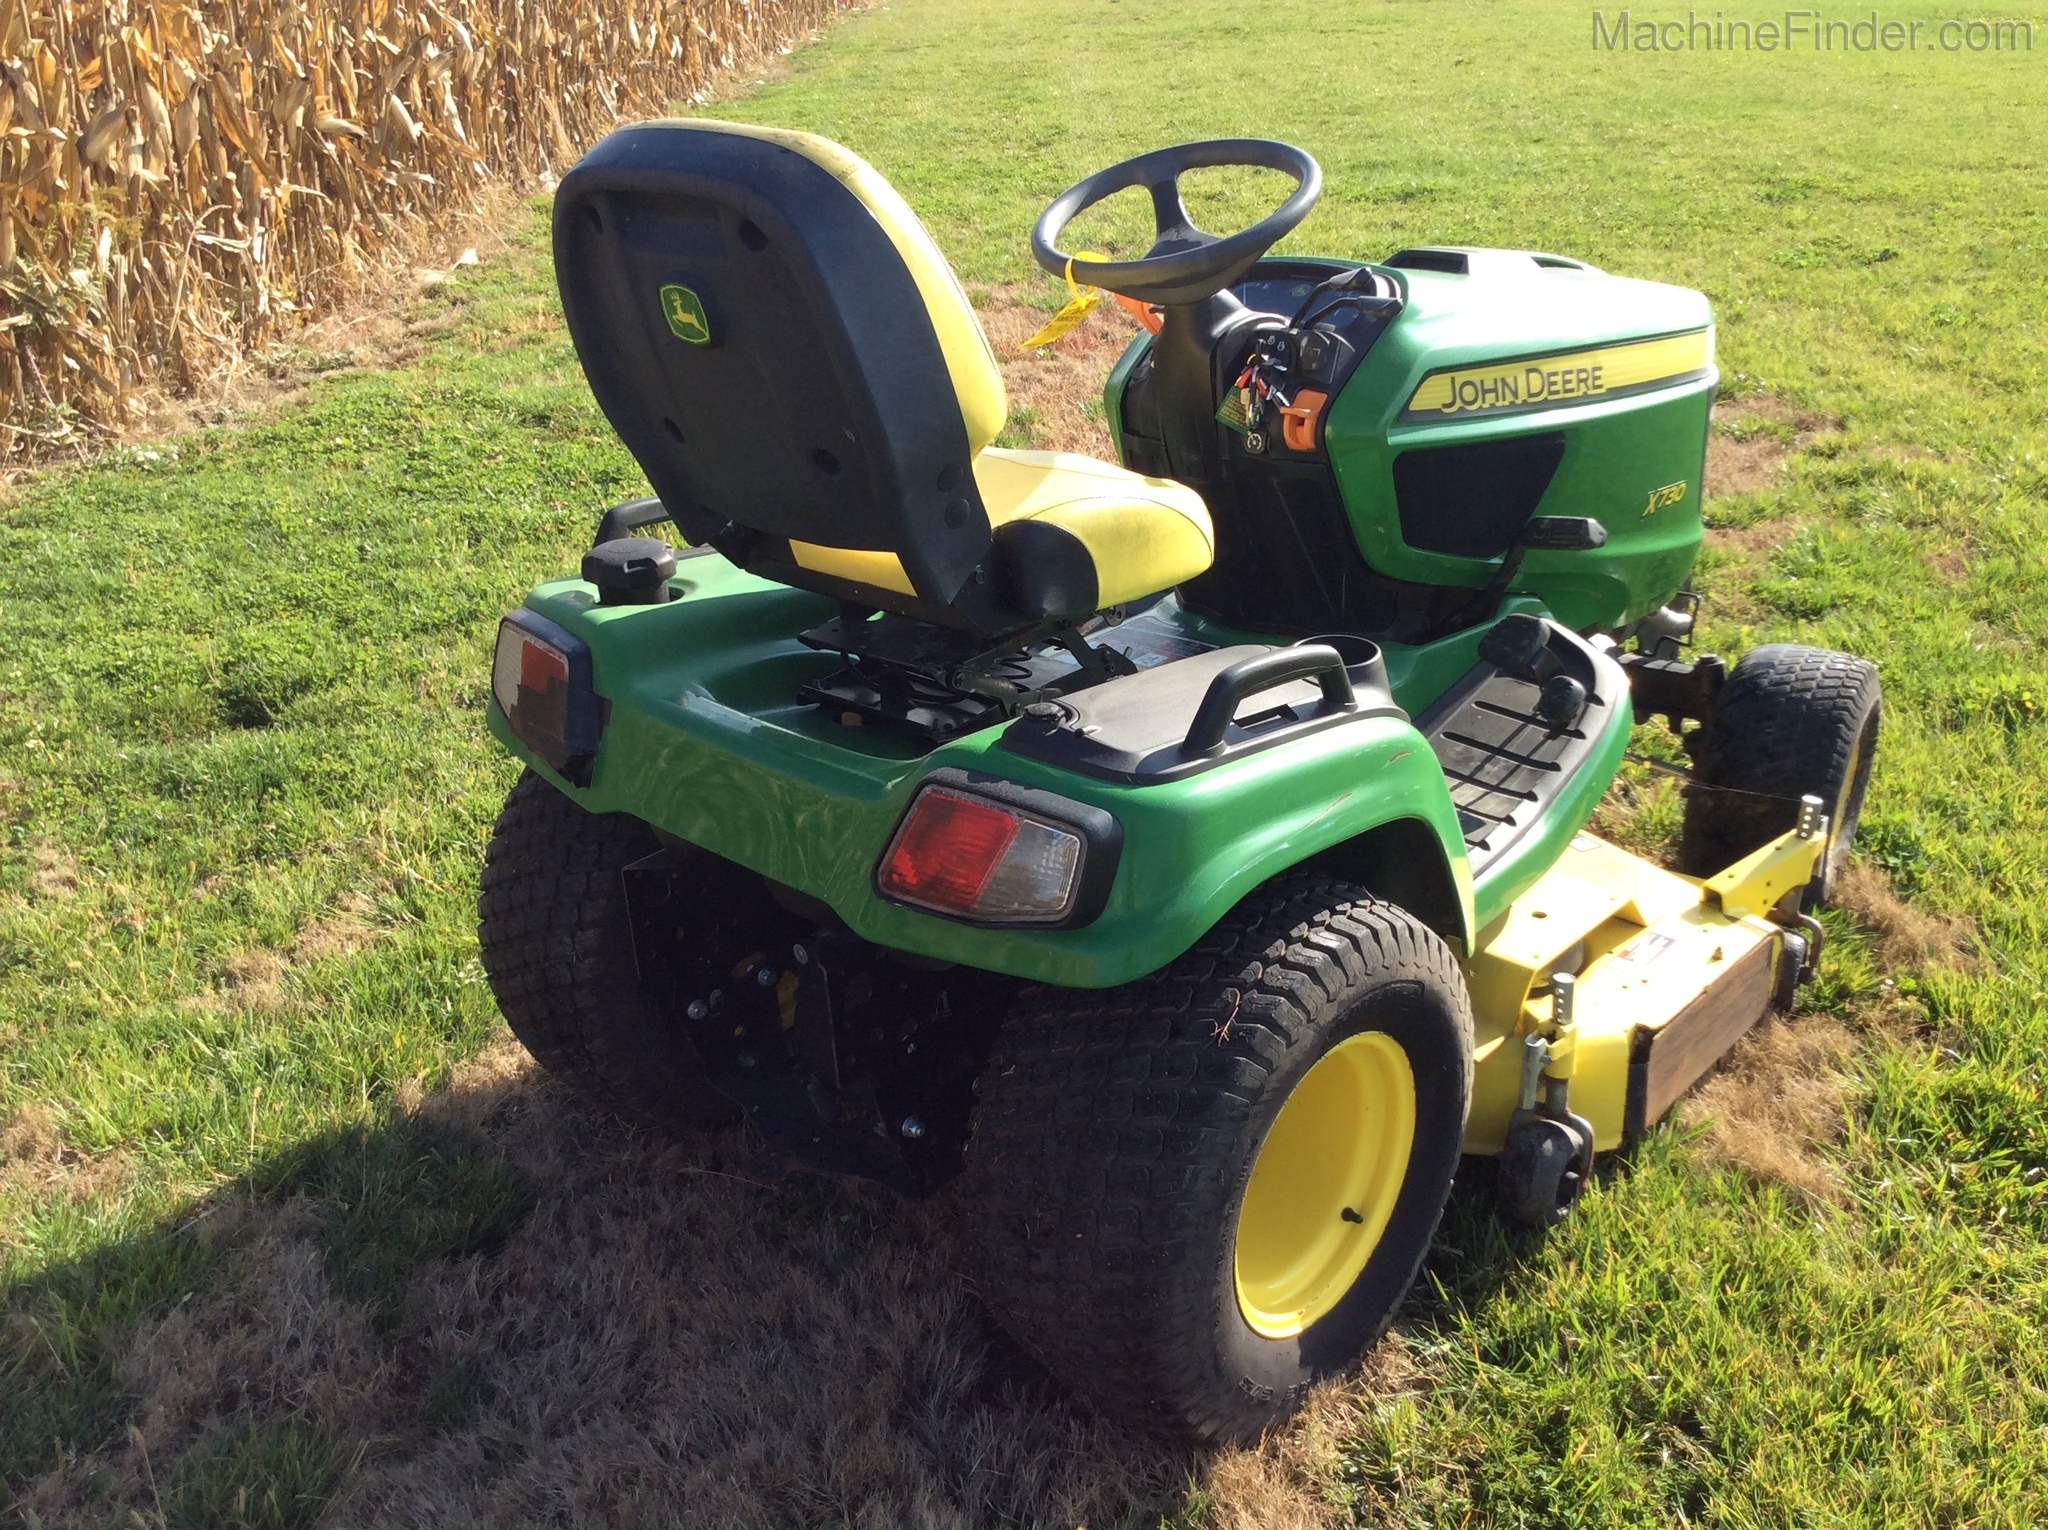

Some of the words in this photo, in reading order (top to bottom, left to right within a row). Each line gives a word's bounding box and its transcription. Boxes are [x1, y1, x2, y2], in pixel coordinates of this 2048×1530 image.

[1441, 376, 1519, 409] JOHN
[1525, 366, 1604, 399] DEERE
[1641, 482, 1687, 517] X730
